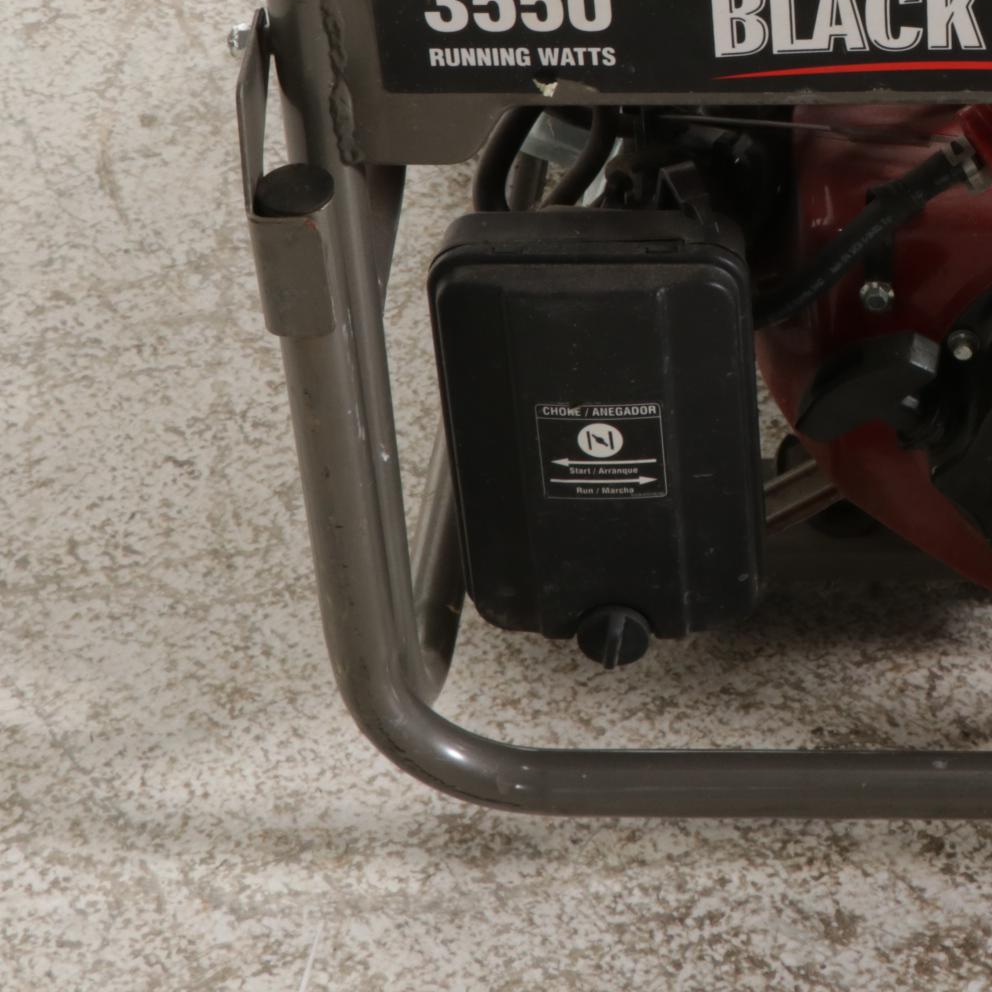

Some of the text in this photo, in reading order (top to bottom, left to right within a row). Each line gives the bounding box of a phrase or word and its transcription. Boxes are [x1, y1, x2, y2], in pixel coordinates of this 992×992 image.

[428, 46, 617, 68] RUNNING WATTS
[592, 405, 657, 417] ANEGADOR
[569, 467, 591, 475] Start
[598, 467, 639, 476] Arranque
